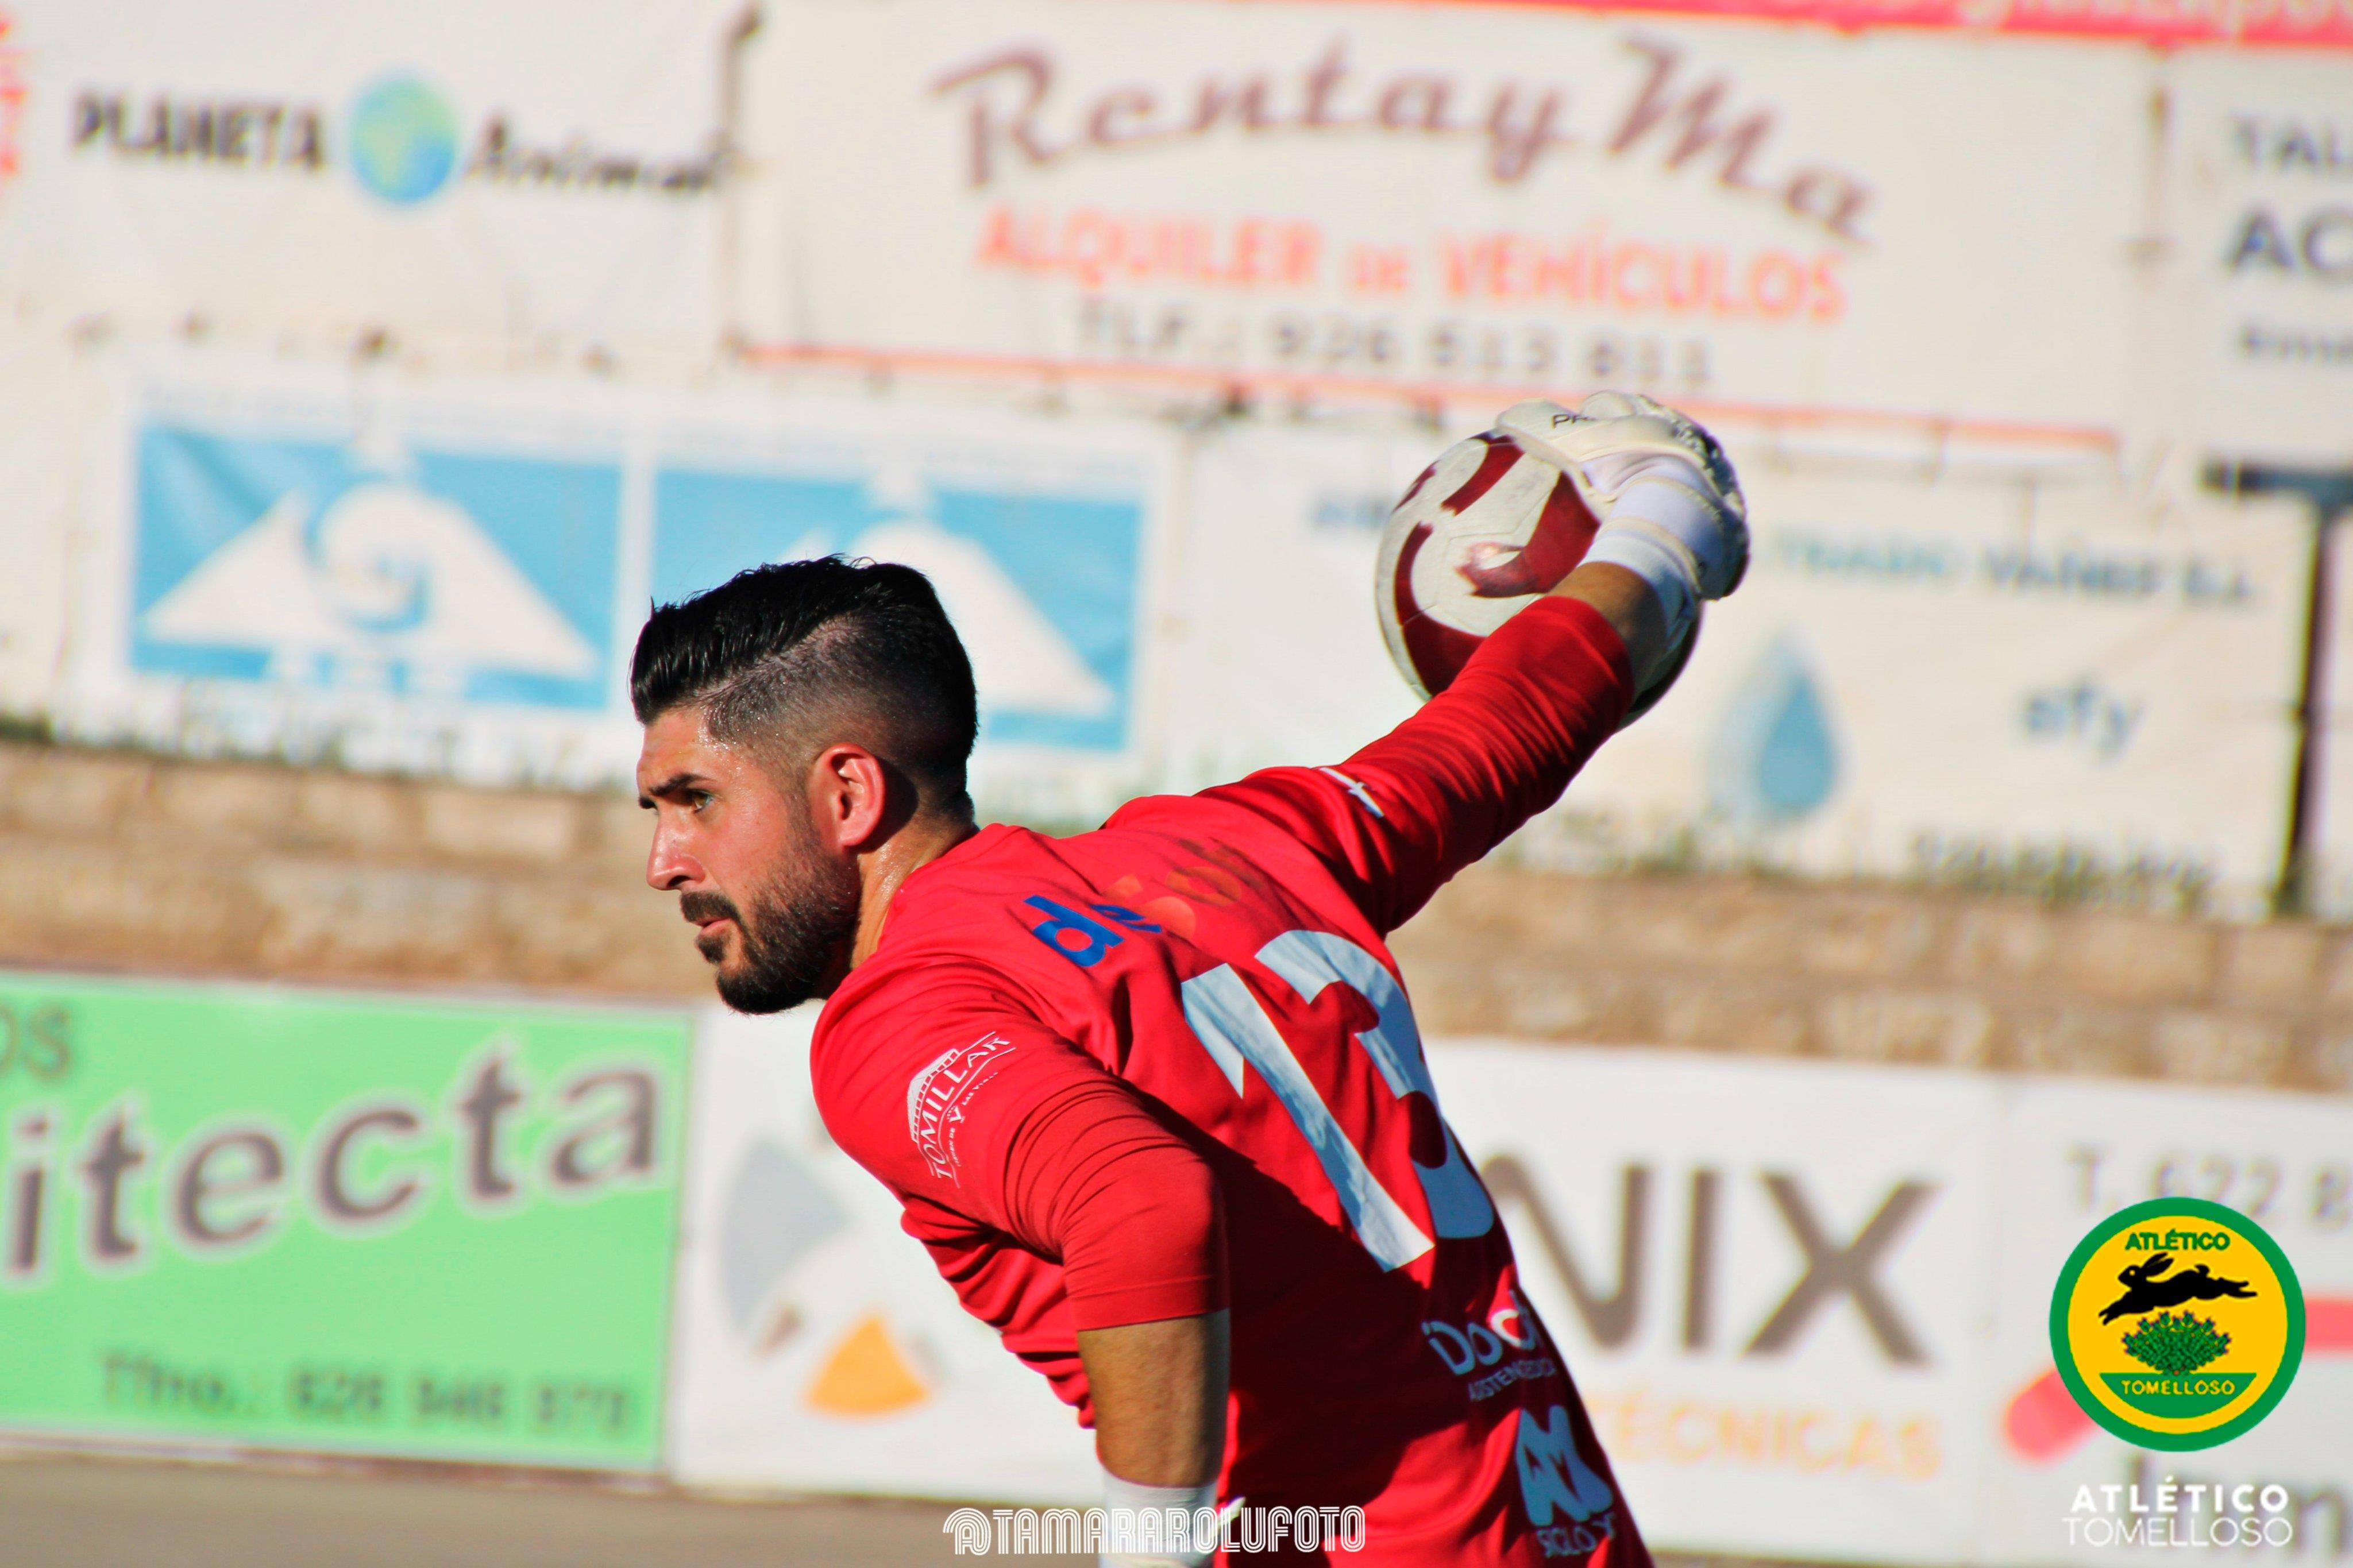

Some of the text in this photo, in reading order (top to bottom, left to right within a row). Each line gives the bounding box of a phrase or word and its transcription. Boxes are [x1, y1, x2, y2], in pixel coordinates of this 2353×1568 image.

[70, 89, 330, 171] PLANETA
[973, 204, 1322, 290] ALQUILER
[1439, 221, 1847, 322] VEHÍCULOS
[10, 1054, 659, 1276] itecta
[920, 1037, 1011, 1179] TOMILLAR
[1181, 928, 1495, 1270] 13
